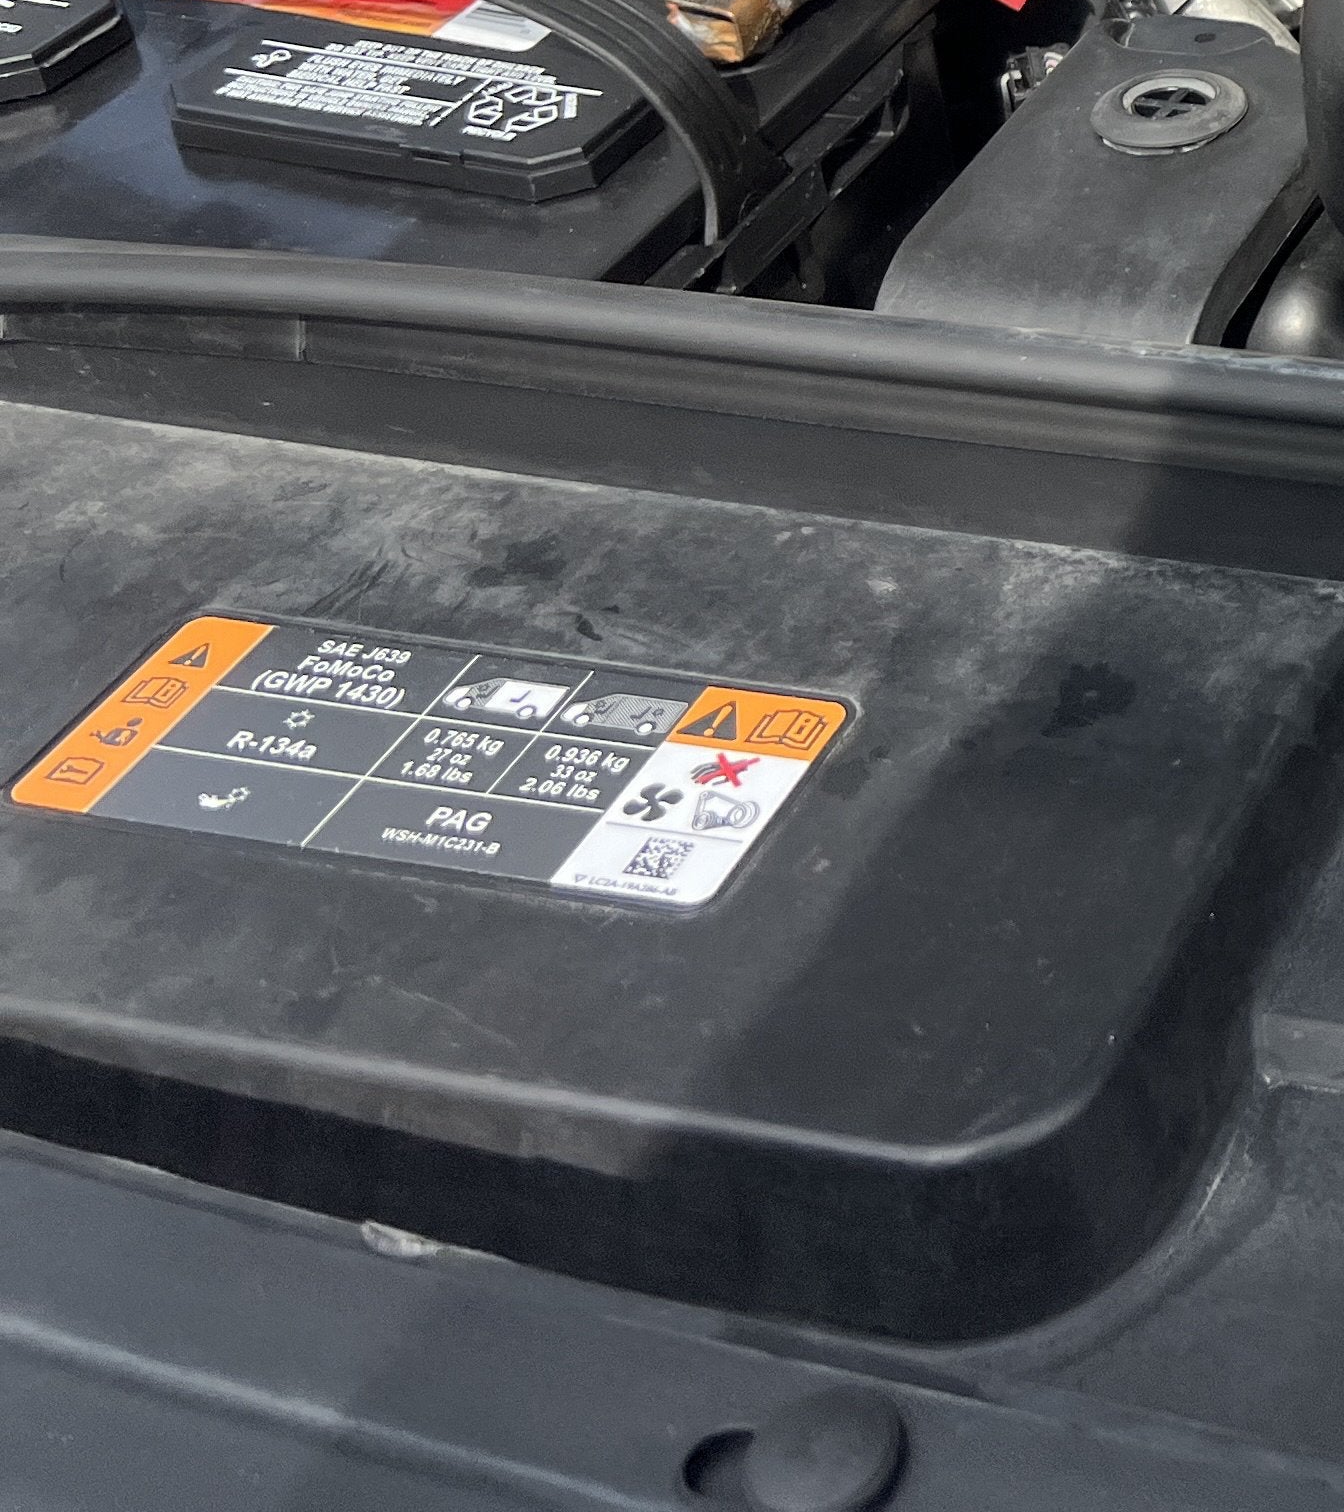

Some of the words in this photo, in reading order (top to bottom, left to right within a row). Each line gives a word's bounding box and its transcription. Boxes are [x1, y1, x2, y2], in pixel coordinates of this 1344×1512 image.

[317, 639, 364, 657] SAE
[362, 646, 412, 664] J639
[297, 655, 396, 682] FoMoCo
[251, 669, 333, 695] (GWP
[335, 681, 405, 709] 1430)
[226, 730, 318, 761] R-134a
[424, 728, 479, 748] 0.765
[476, 735, 505, 756] kg
[426, 747, 452, 762] 27
[450, 753, 472, 766] oz
[544, 745, 602, 766] 0.936
[601, 752, 631, 773] kg
[401, 761, 441, 778] 1.68
[441, 768, 473, 784] lbs
[550, 764, 574, 779] 33
[574, 770, 598, 783] oz
[518, 777, 567, 795] 2.06
[566, 784, 601, 801] lbs
[426, 806, 493, 832] PAG
[381, 827, 501, 855] WSH-M1C231-B
